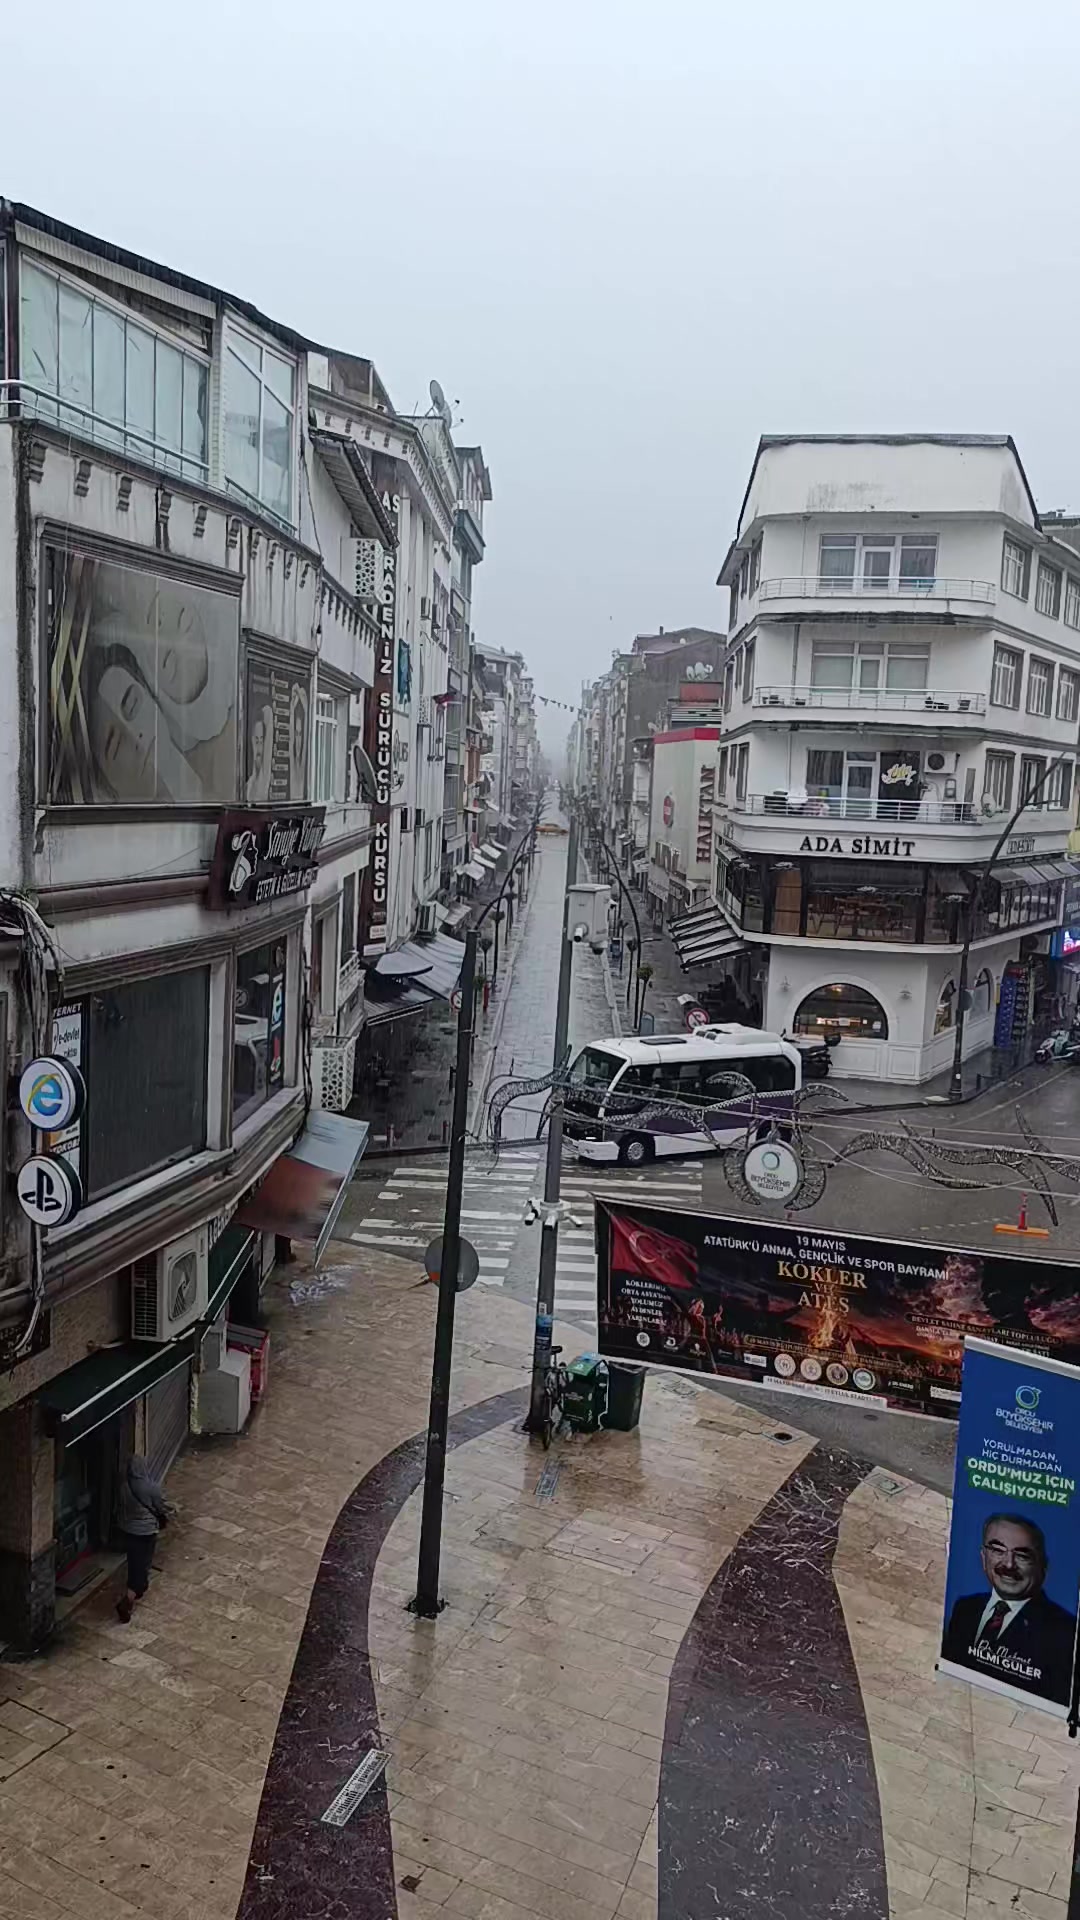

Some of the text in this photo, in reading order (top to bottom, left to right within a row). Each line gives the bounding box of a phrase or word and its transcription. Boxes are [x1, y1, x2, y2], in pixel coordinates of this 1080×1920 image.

[380, 556, 395, 674] RADENİZ
[377, 692, 392, 805] SÜRÜCÜ
[800, 836, 916, 856] ADA SİMİT
[374, 822, 388, 902] KURSU
[797, 1236, 846, 1251] 19 MAYIS
[704, 1236, 948, 1280] ATATÜRK'Ü ANMA, GENÇLİK VE SPOR BAYRAMI
[777, 1259, 868, 1289] KÖKLER
[798, 1291, 850, 1317] ATEŞ
[982, 1448, 1062, 1473] HİÇ DURMADAN
[983, 1438, 1058, 1463] YORULMADAN,
[968, 1457, 1042, 1484] ORDU'MUZ
[972, 1474, 1068, 1504] ÇALIŞIYORUZ
